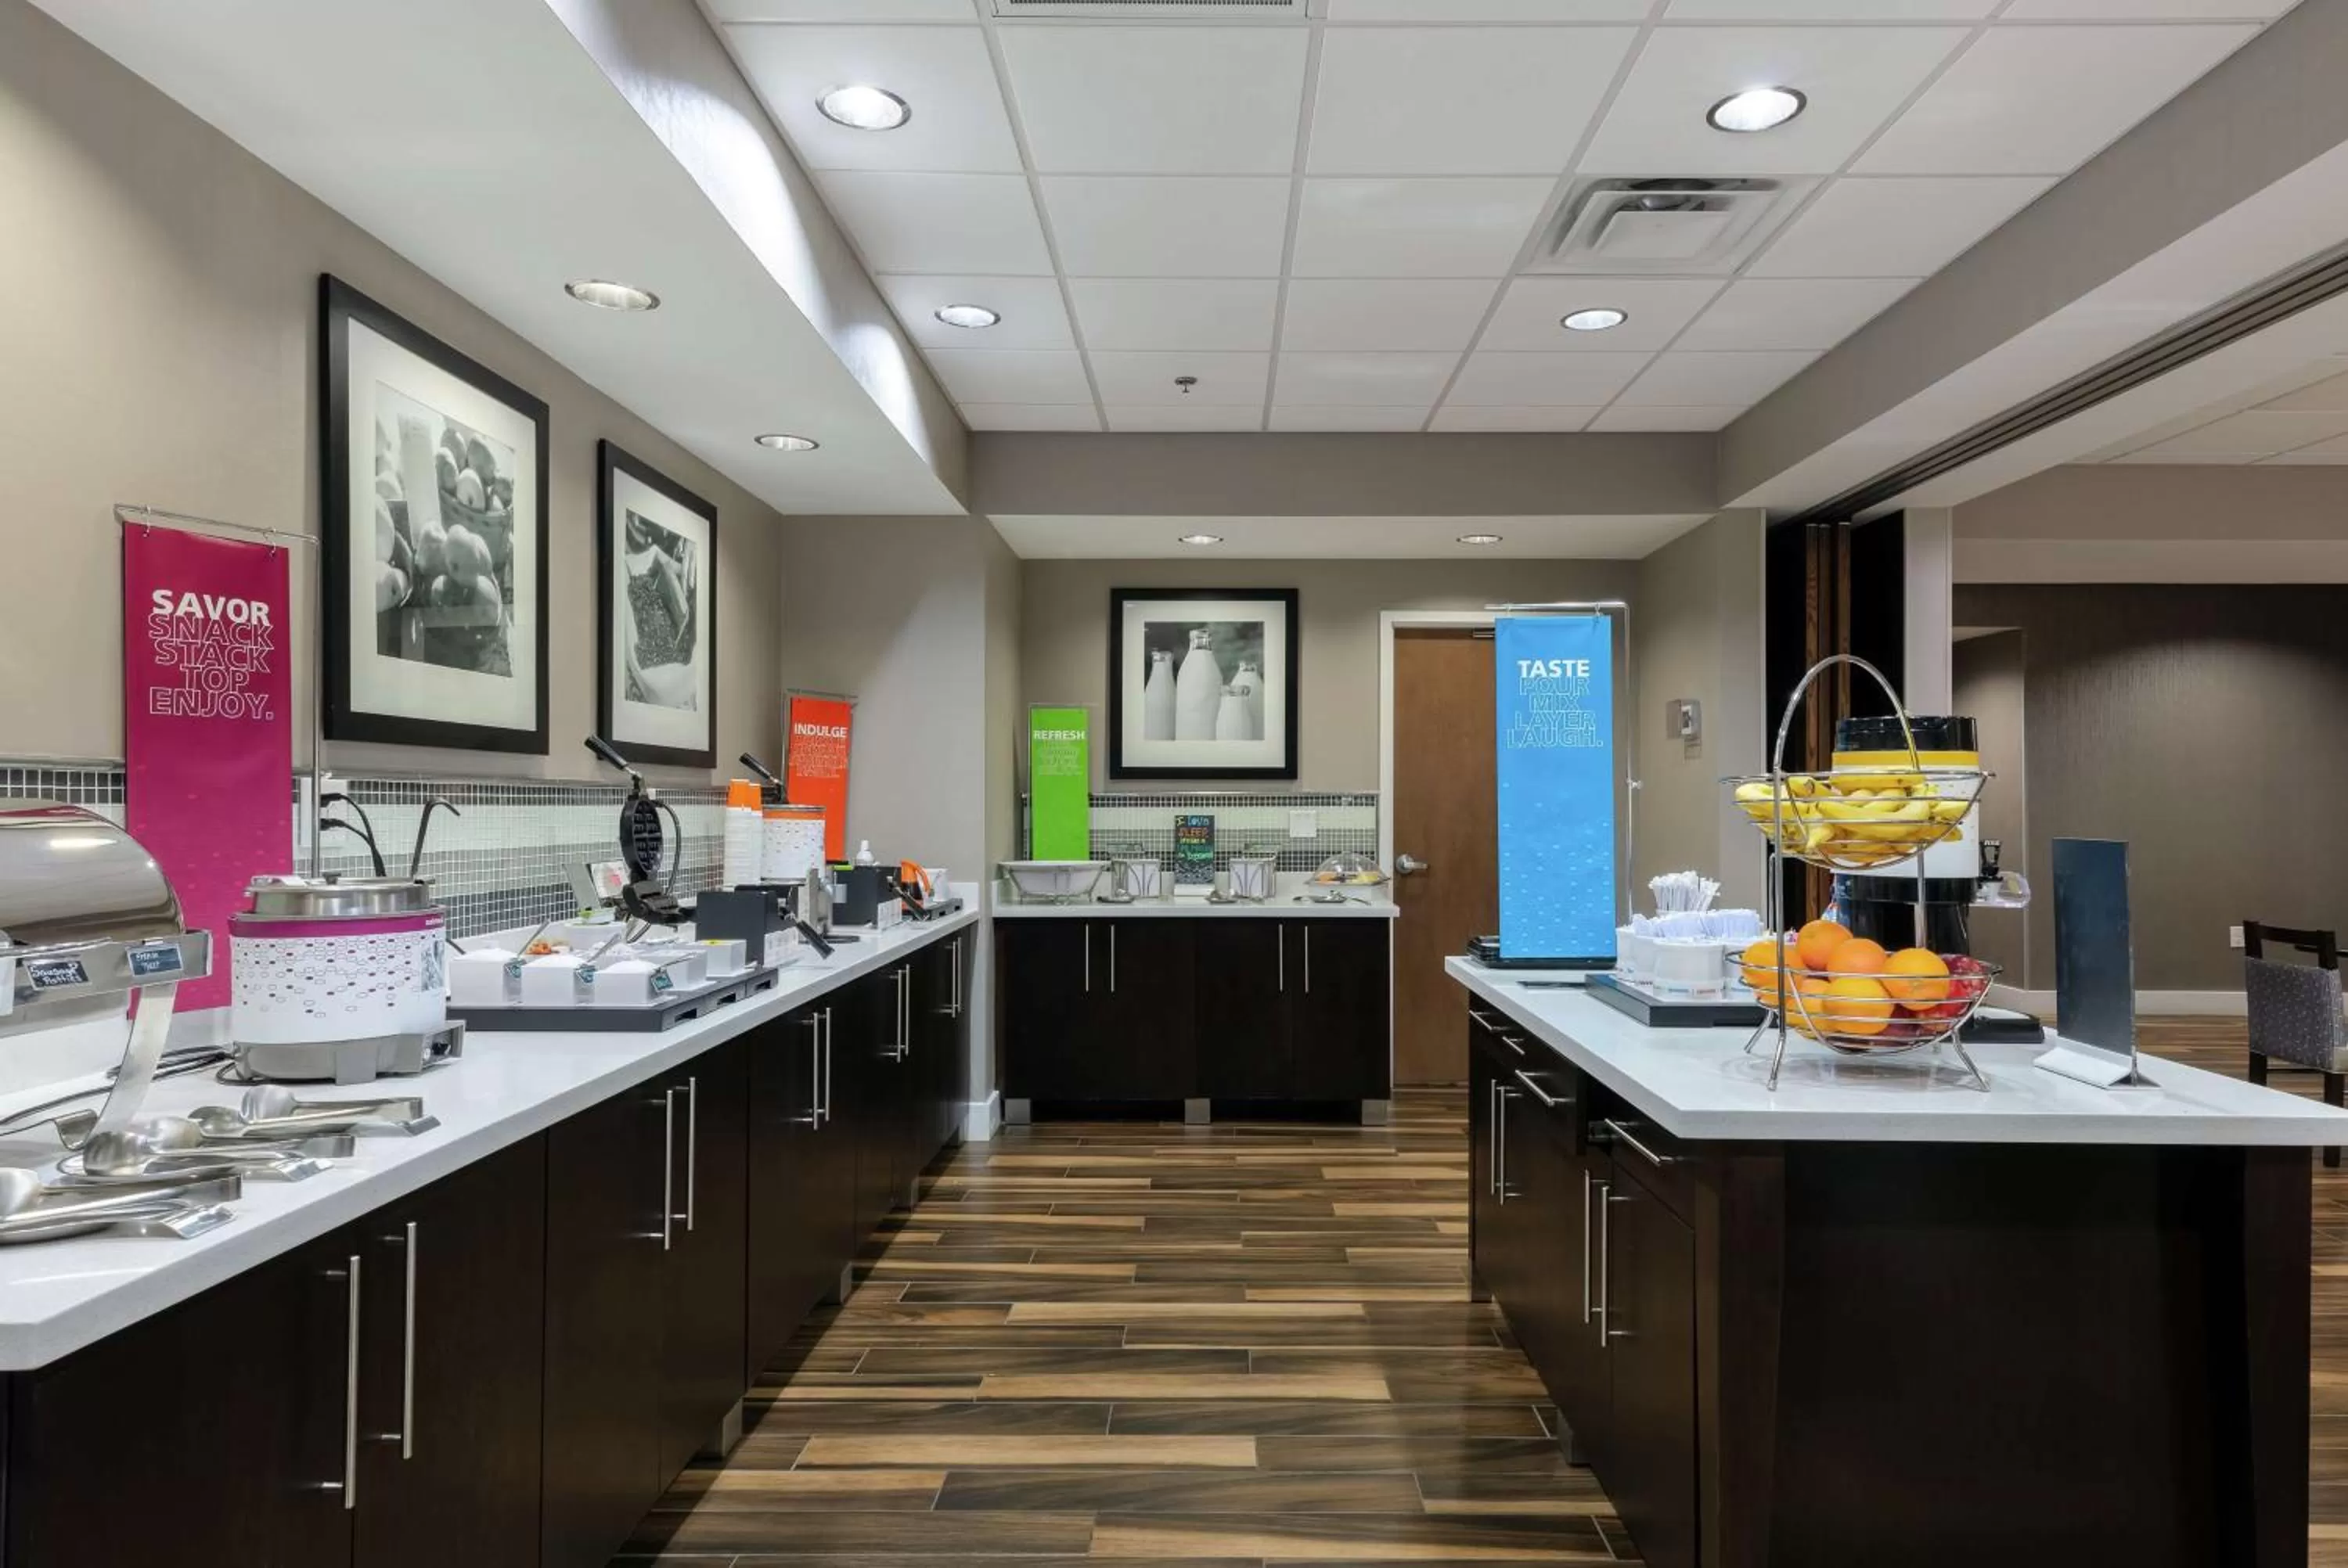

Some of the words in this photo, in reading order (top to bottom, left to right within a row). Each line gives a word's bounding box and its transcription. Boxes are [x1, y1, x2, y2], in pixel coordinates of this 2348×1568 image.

[153, 589, 269, 626] SAVOR
[149, 613, 274, 649] SNACK
[155, 638, 271, 673] STACK
[180, 664, 249, 692] TOP
[1518, 660, 1590, 678] TASTE
[1519, 676, 1590, 696] POUR
[149, 687, 274, 720] ENJOY.
[1529, 694, 1580, 713] MIX
[1515, 710, 1596, 729] LAYER
[794, 723, 848, 738] INDULGE
[1034, 730, 1085, 739] REFRESH
[1507, 728, 1604, 748] LAUGH.
